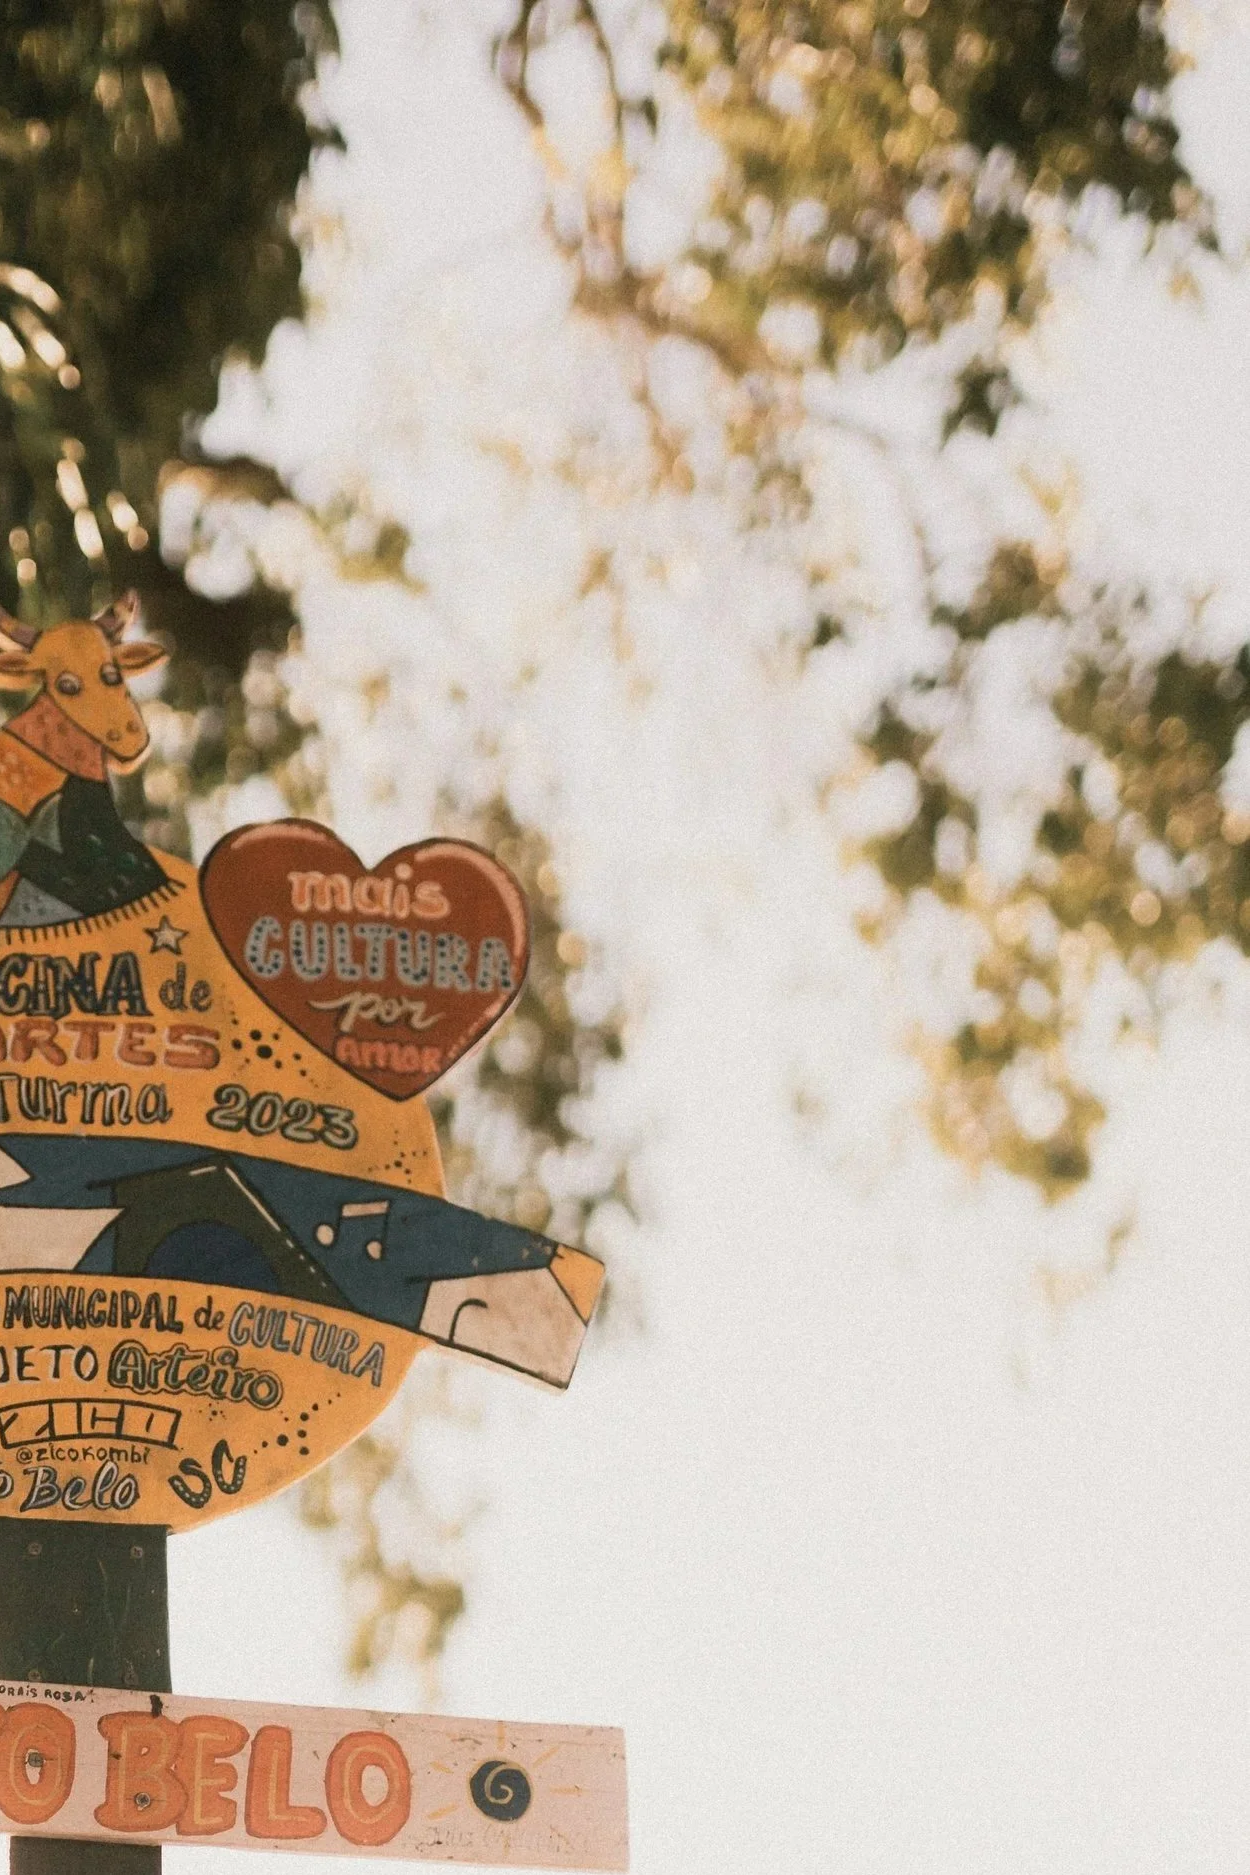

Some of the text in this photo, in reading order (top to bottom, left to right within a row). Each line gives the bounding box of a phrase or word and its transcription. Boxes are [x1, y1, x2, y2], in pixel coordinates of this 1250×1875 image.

[159, 962, 212, 1012] de
[245, 917, 515, 992] CULTURA
[310, 991, 445, 1033] por
[207, 1085, 359, 1151] 2023
[4, 1286, 183, 1332] MUNICIPAL
[194, 1296, 223, 1330] de
[229, 1302, 384, 1387] CULTURA
[108, 1339, 283, 1410] Arteiro
[20, 1459, 140, 1512] Belo
[168, 1439, 247, 1508] SC
[94, 1710, 411, 1846] BELO
